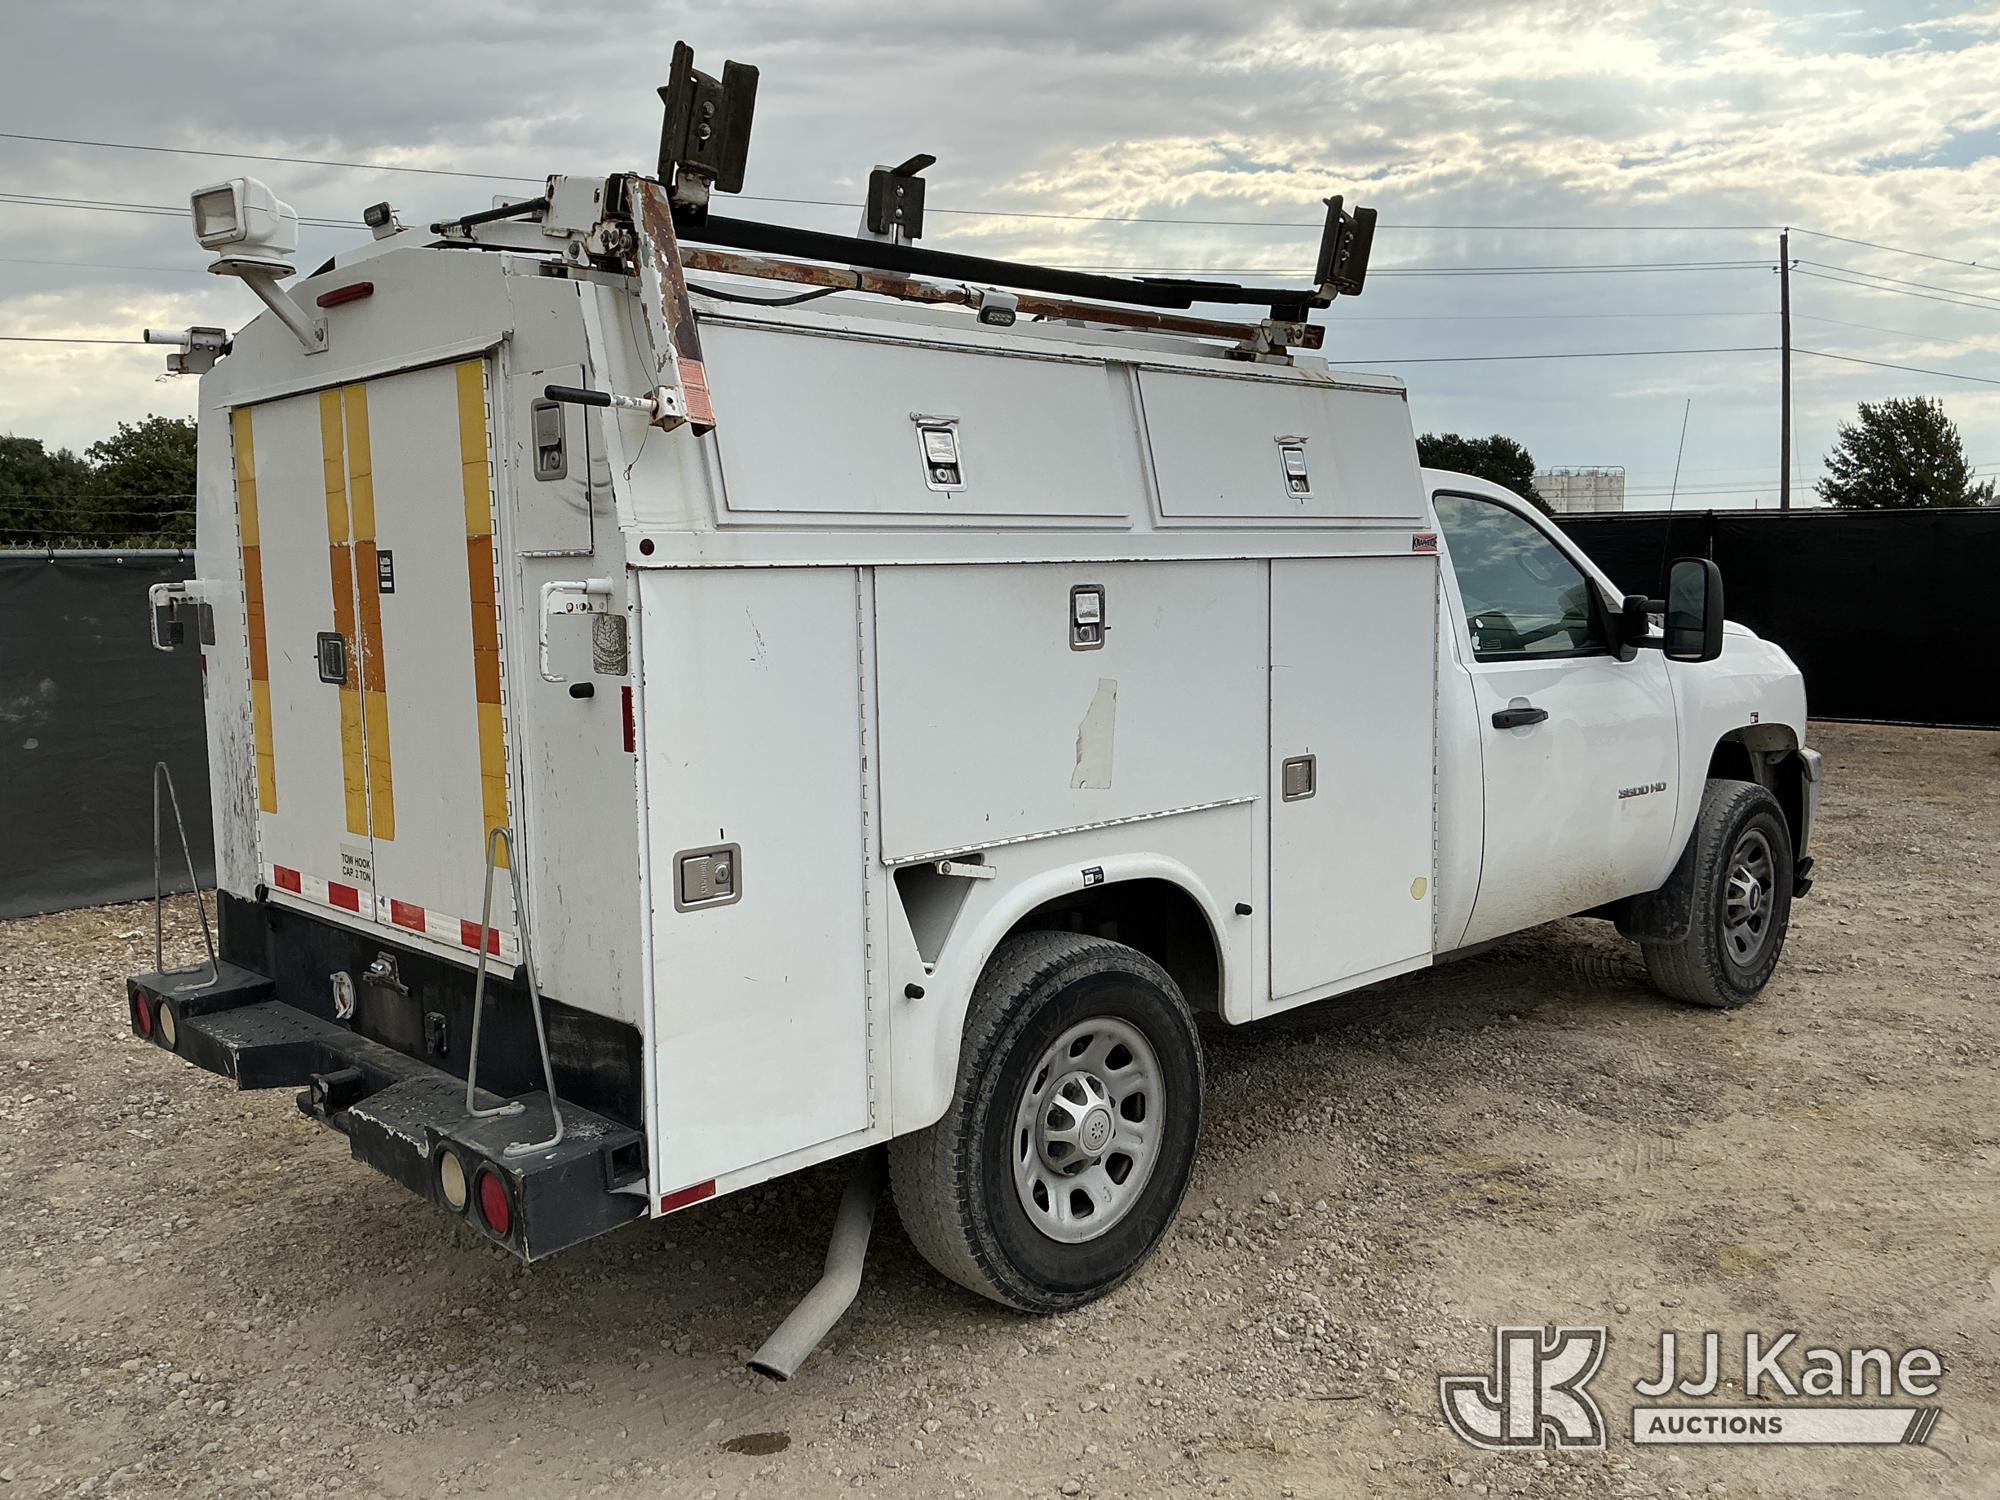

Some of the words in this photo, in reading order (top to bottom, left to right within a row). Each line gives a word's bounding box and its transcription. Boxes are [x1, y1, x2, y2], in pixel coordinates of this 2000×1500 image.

[1650, 782, 1667, 794] HD
[341, 852, 354, 866] TOW
[354, 856, 371, 870] HOOK
[355, 869, 359, 879] 2
[359, 870, 371, 882] TON
